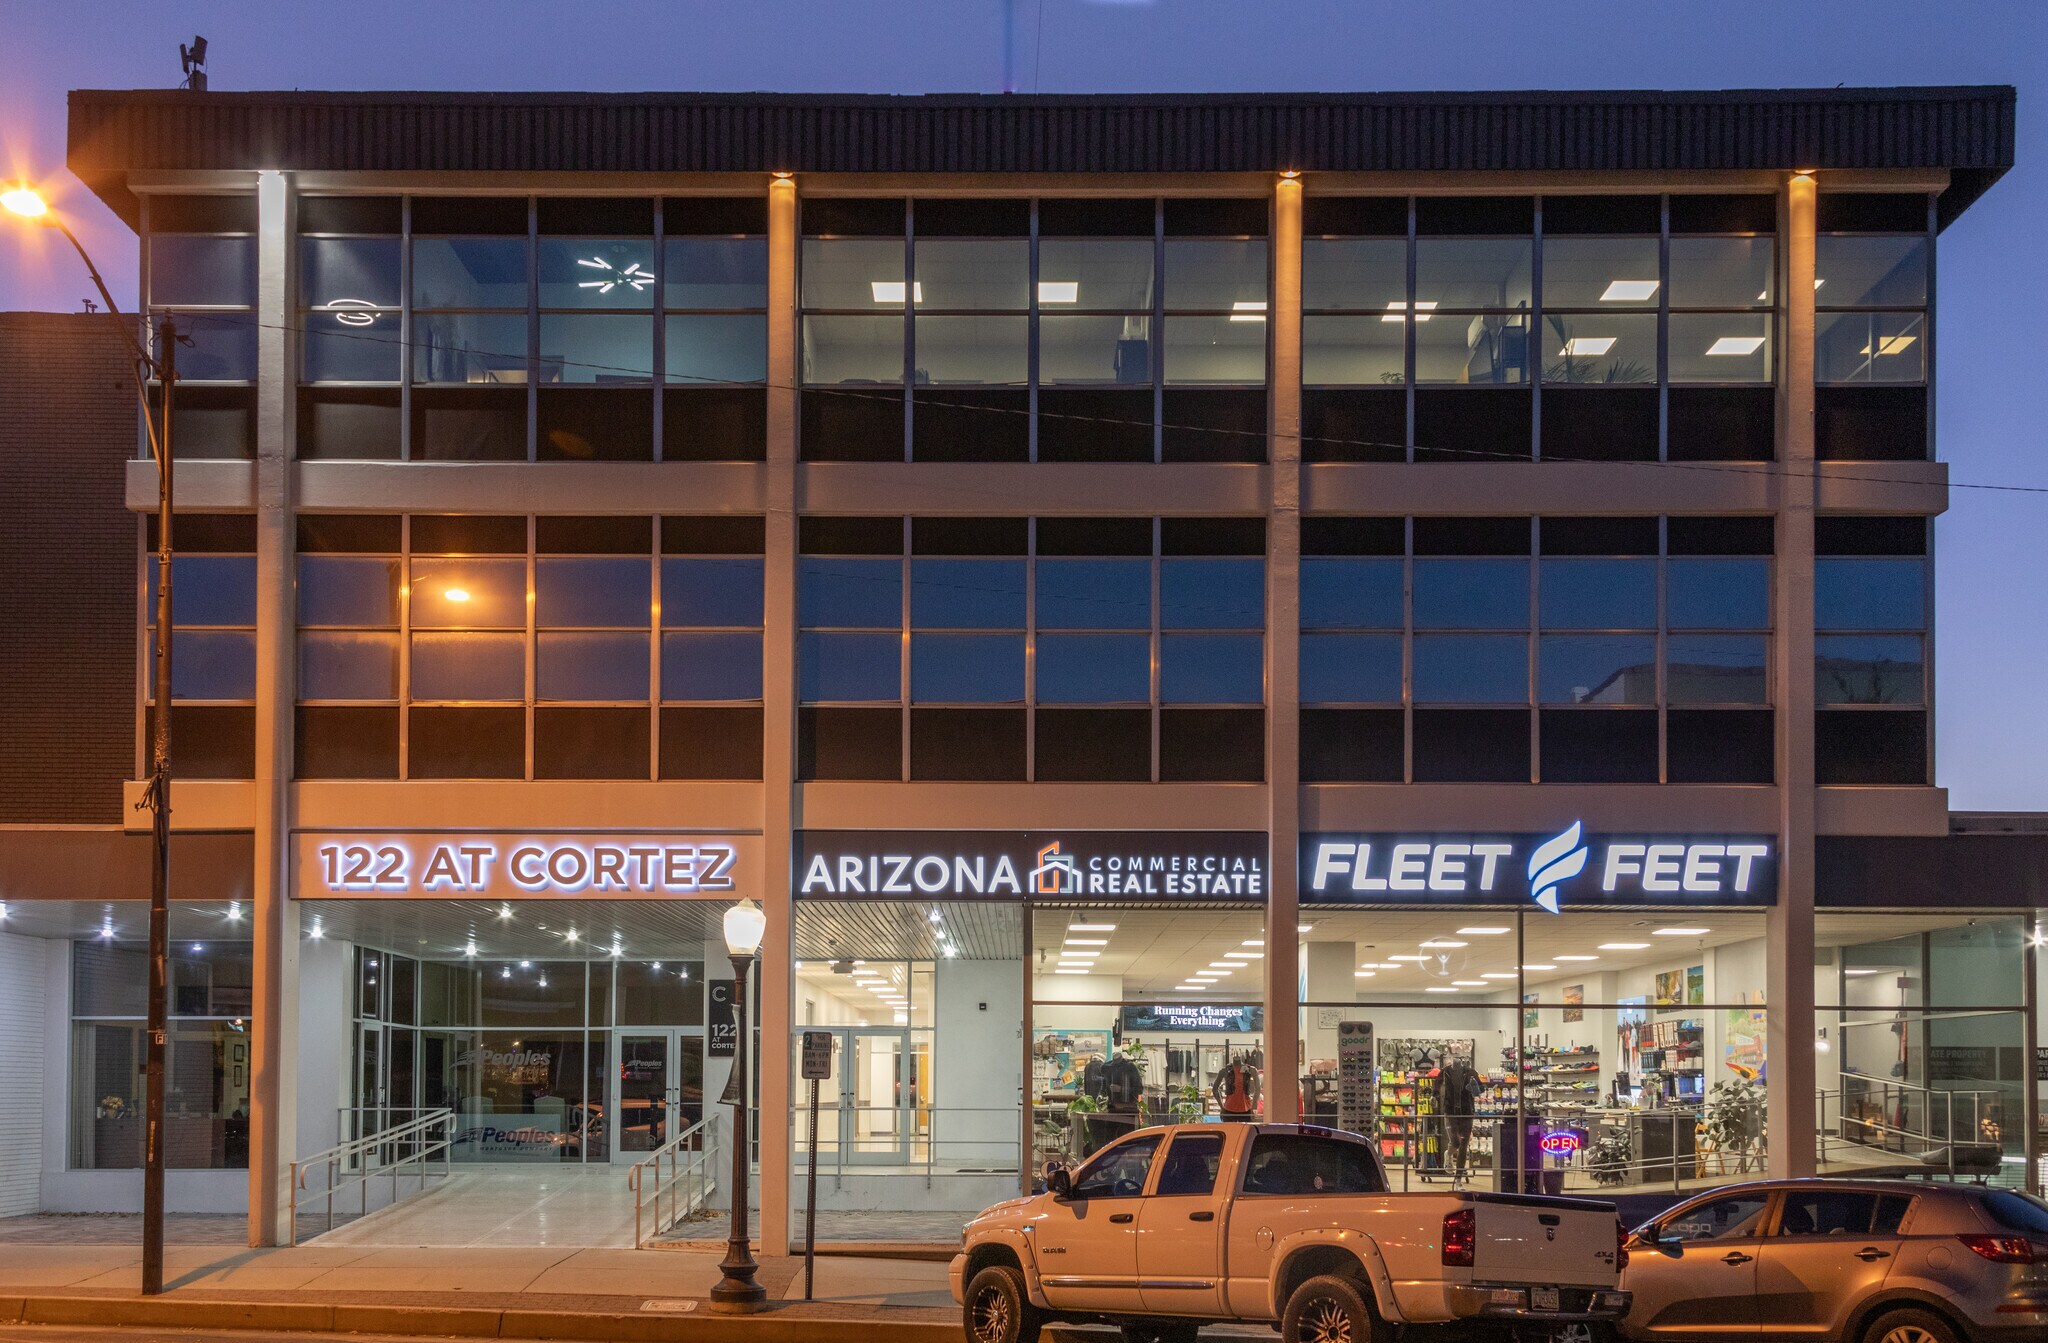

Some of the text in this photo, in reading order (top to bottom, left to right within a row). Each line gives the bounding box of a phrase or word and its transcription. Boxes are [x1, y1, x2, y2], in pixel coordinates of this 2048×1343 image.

[320, 845, 732, 886] 122 AT CORTEZ
[1089, 856, 1261, 872] COMMERCIAL
[1312, 843, 1768, 892] FLEET FEET
[801, 854, 1021, 893] ARIZONA
[1090, 873, 1261, 894] REAL ESTATE
[711, 985, 727, 1002] C
[1154, 1005, 1243, 1018] Running Changes
[1170, 1015, 1225, 1027] Everything
[711, 1023, 737, 1037] 122
[805, 1035, 811, 1047] 2
[1341, 1036, 1371, 1047] goodr
[481, 1049, 552, 1069] Peoples
[636, 1060, 663, 1068] Peoples
[481, 1127, 556, 1146] Peoples
[1540, 1137, 1579, 1150] OPEN
